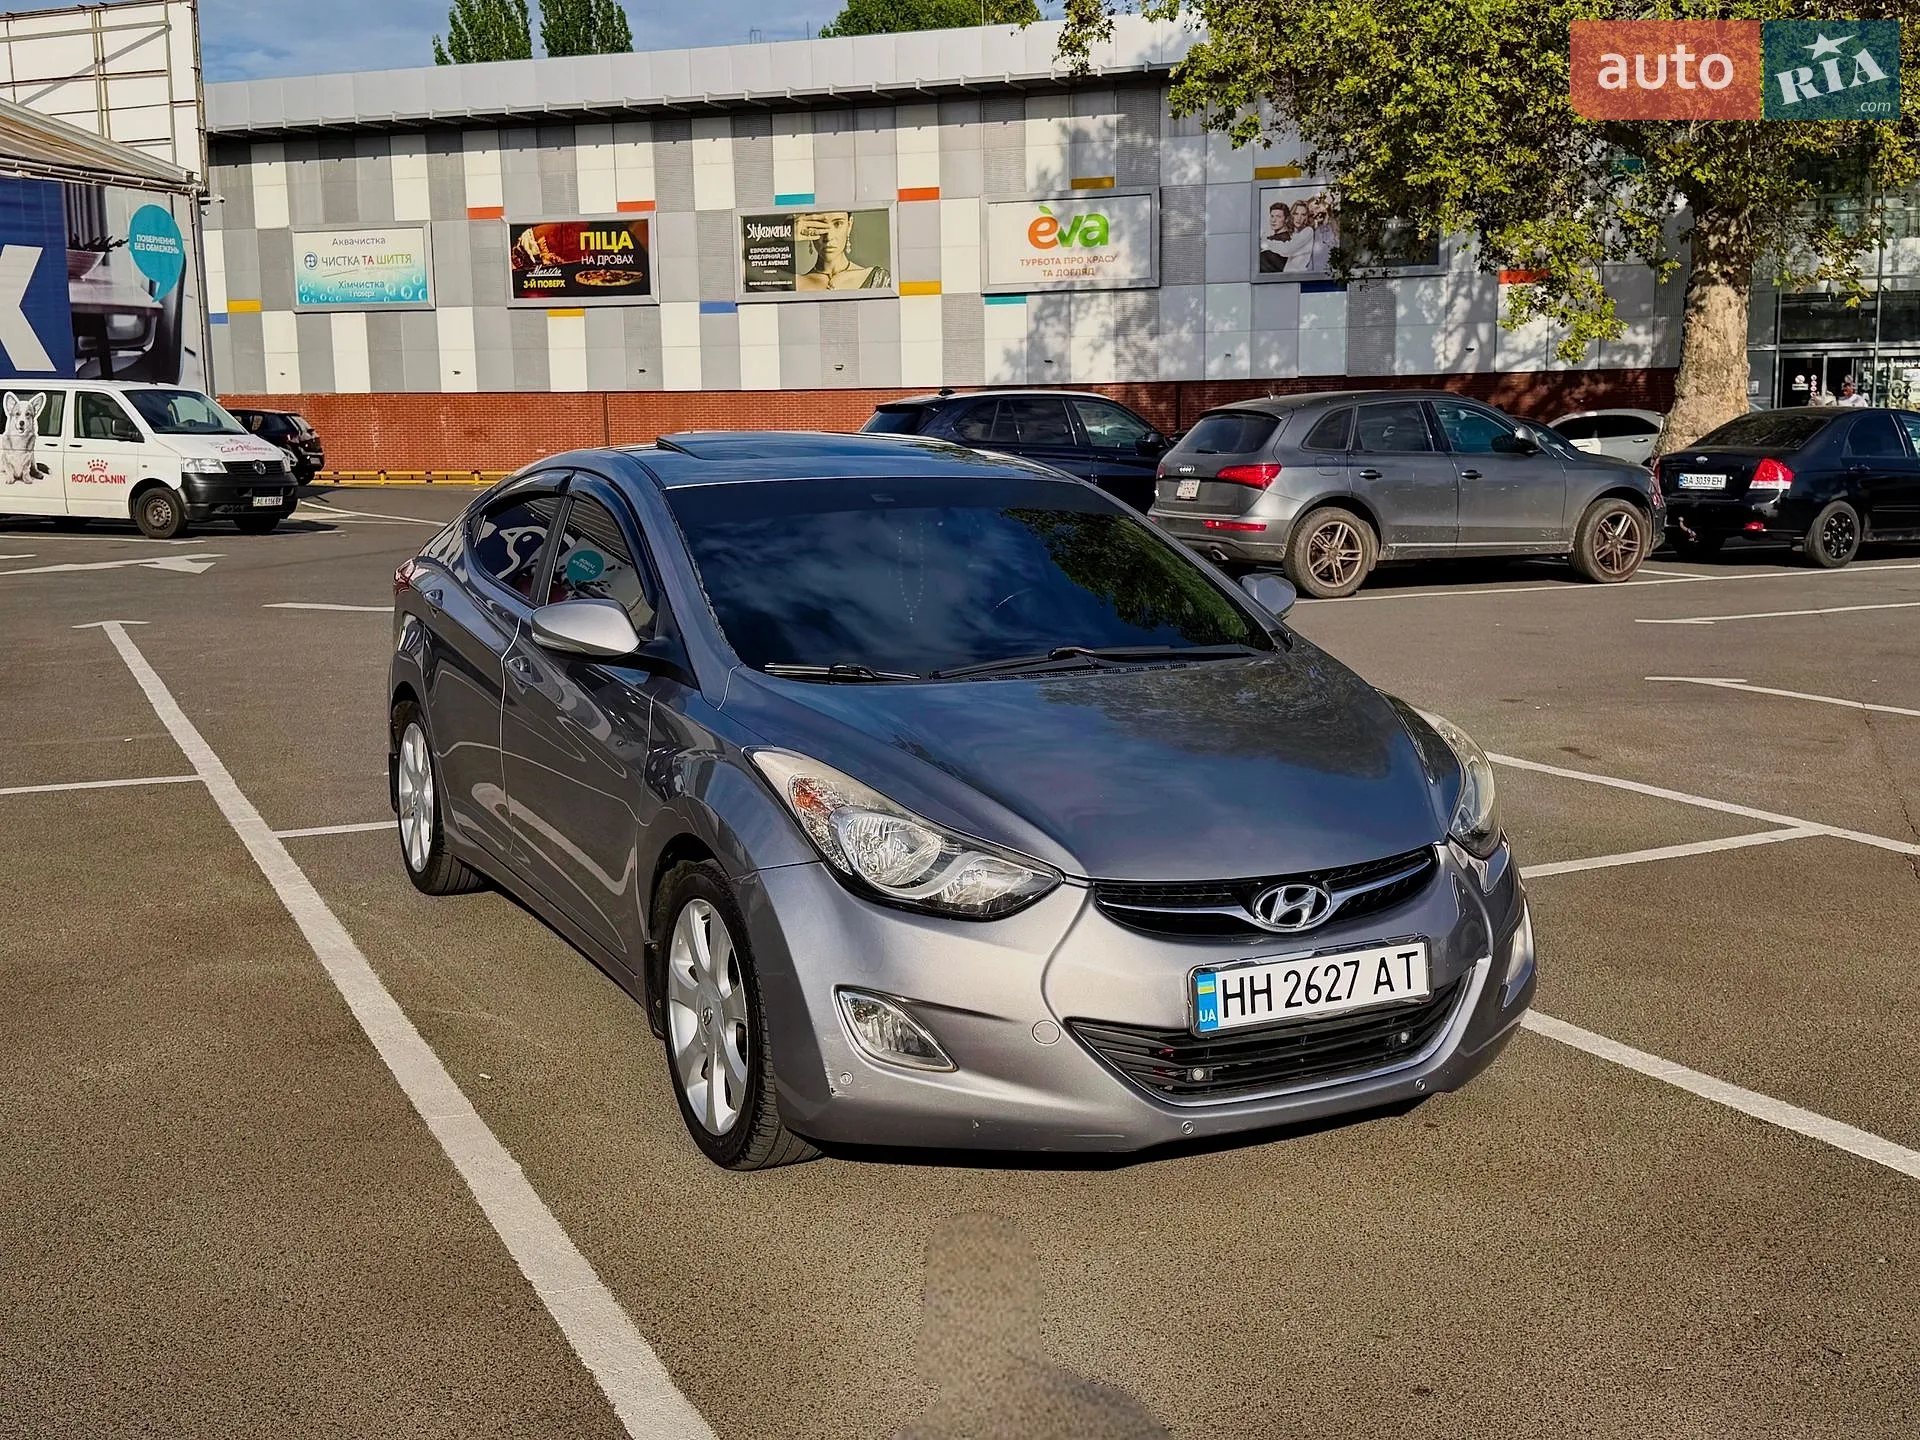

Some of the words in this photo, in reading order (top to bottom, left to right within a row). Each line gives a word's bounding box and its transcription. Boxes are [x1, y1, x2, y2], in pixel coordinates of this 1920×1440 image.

[331, 237, 386, 246] Аквачистка
[579, 230, 635, 253] ПІЦА
[321, 255, 361, 267] ЧИСТКА
[362, 255, 375, 265] ТА
[376, 254, 412, 265] ШИТТЯ
[581, 256, 595, 265] НА
[596, 254, 635, 266] ДРОВАХ
[1019, 257, 1062, 267] ТУРБОТА
[1063, 256, 1084, 265] ПРО
[1086, 254, 1119, 264] КРАСУ
[1042, 269, 1054, 277] ТА
[338, 280, 385, 289] Хімчистка
[537, 279, 566, 289] ПОВЕРХ
[71, 473, 98, 483] ROYAL
[98, 474, 126, 485] CANIN
[1221, 972, 1274, 1019] HH
[1283, 959, 1361, 1010] 2627
[1372, 950, 1419, 995] AT
[1200, 1010, 1217, 1023] UA
